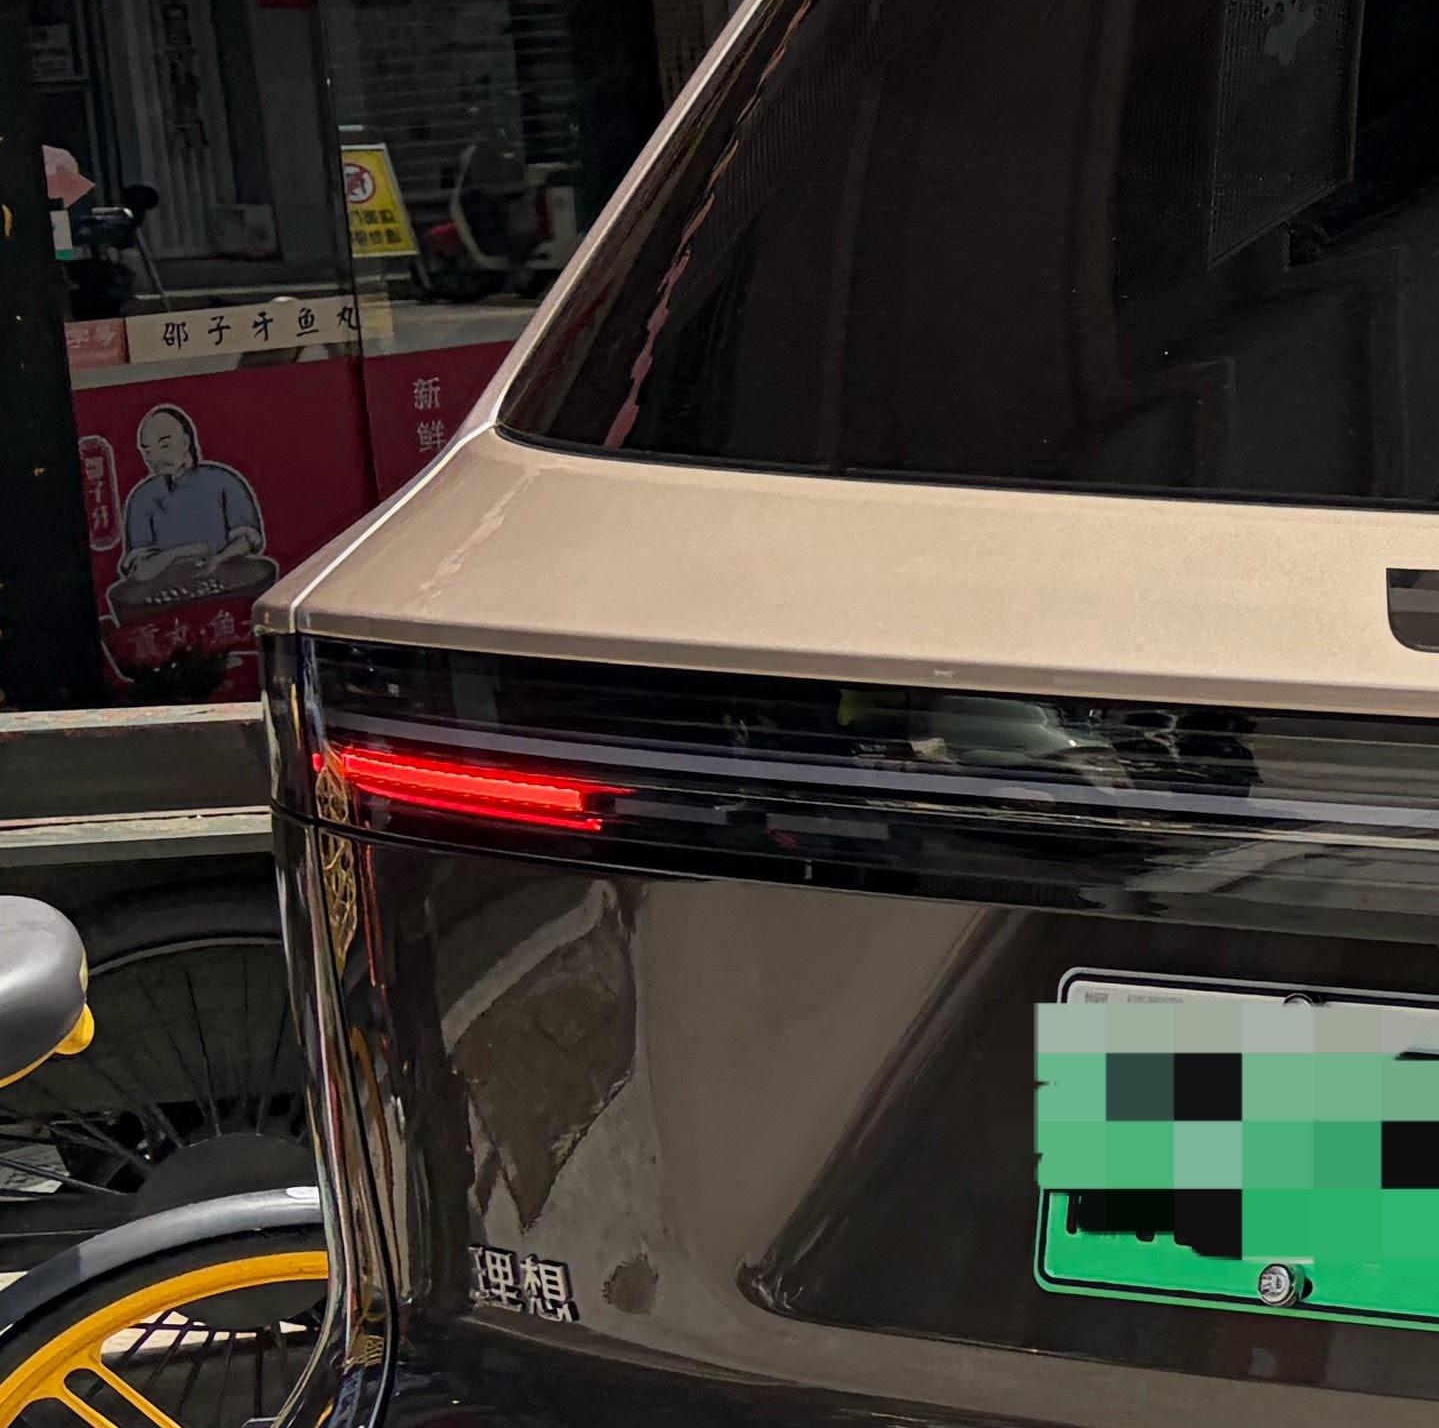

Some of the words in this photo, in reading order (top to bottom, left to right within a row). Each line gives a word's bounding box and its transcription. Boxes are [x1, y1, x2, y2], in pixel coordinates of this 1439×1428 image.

[162, 305, 361, 350] 邵子牙鱼丸
[468, 1244, 577, 1323] 理想
